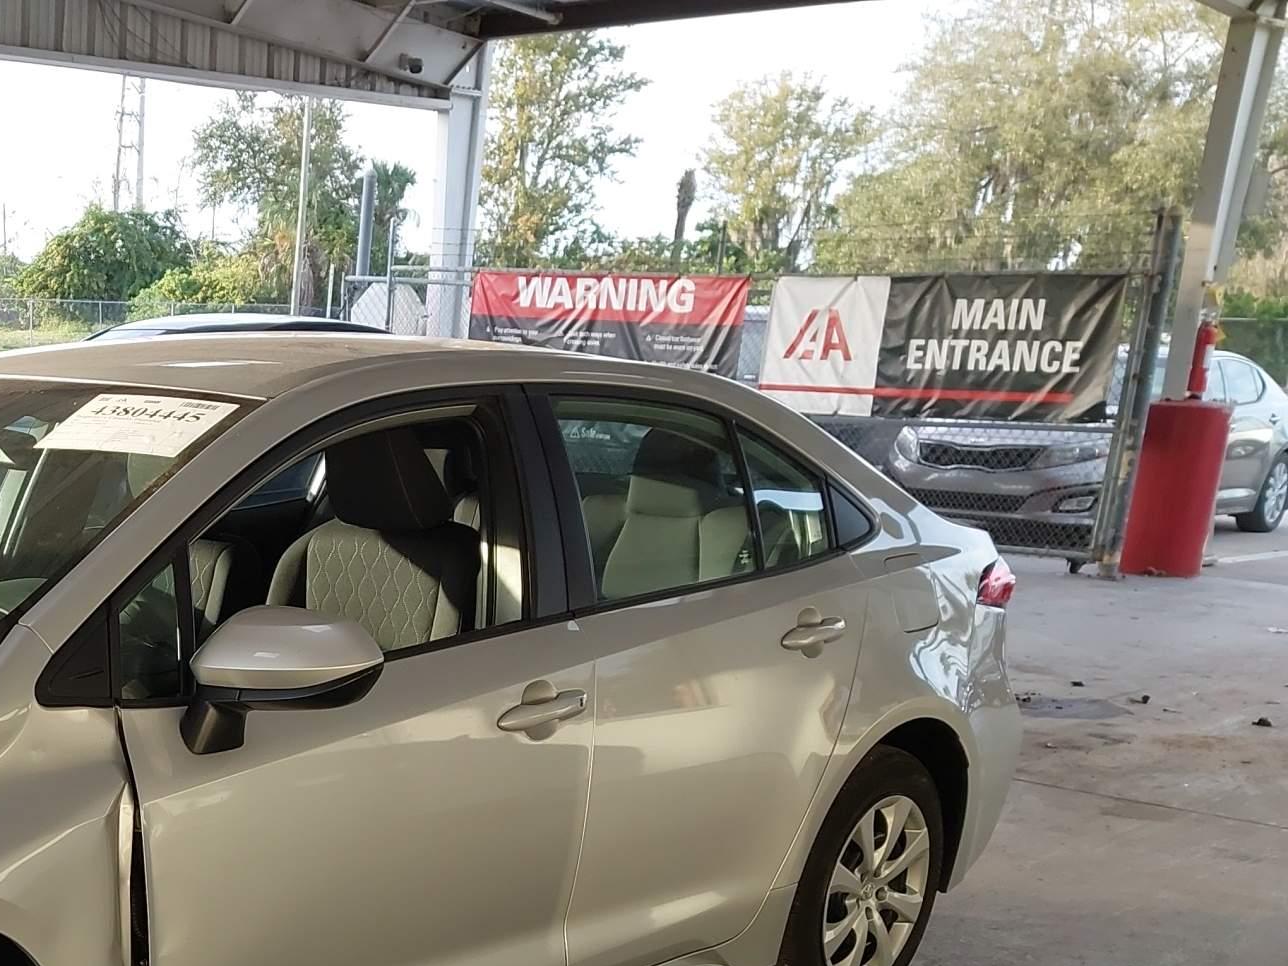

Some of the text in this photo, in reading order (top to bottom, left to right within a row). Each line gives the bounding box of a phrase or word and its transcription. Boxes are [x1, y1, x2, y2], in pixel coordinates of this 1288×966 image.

[517, 276, 696, 313] WARNING
[951, 298, 1047, 331] MAIN
[906, 338, 1083, 374] ENTRANCE
[91, 404, 207, 424] 43804445
